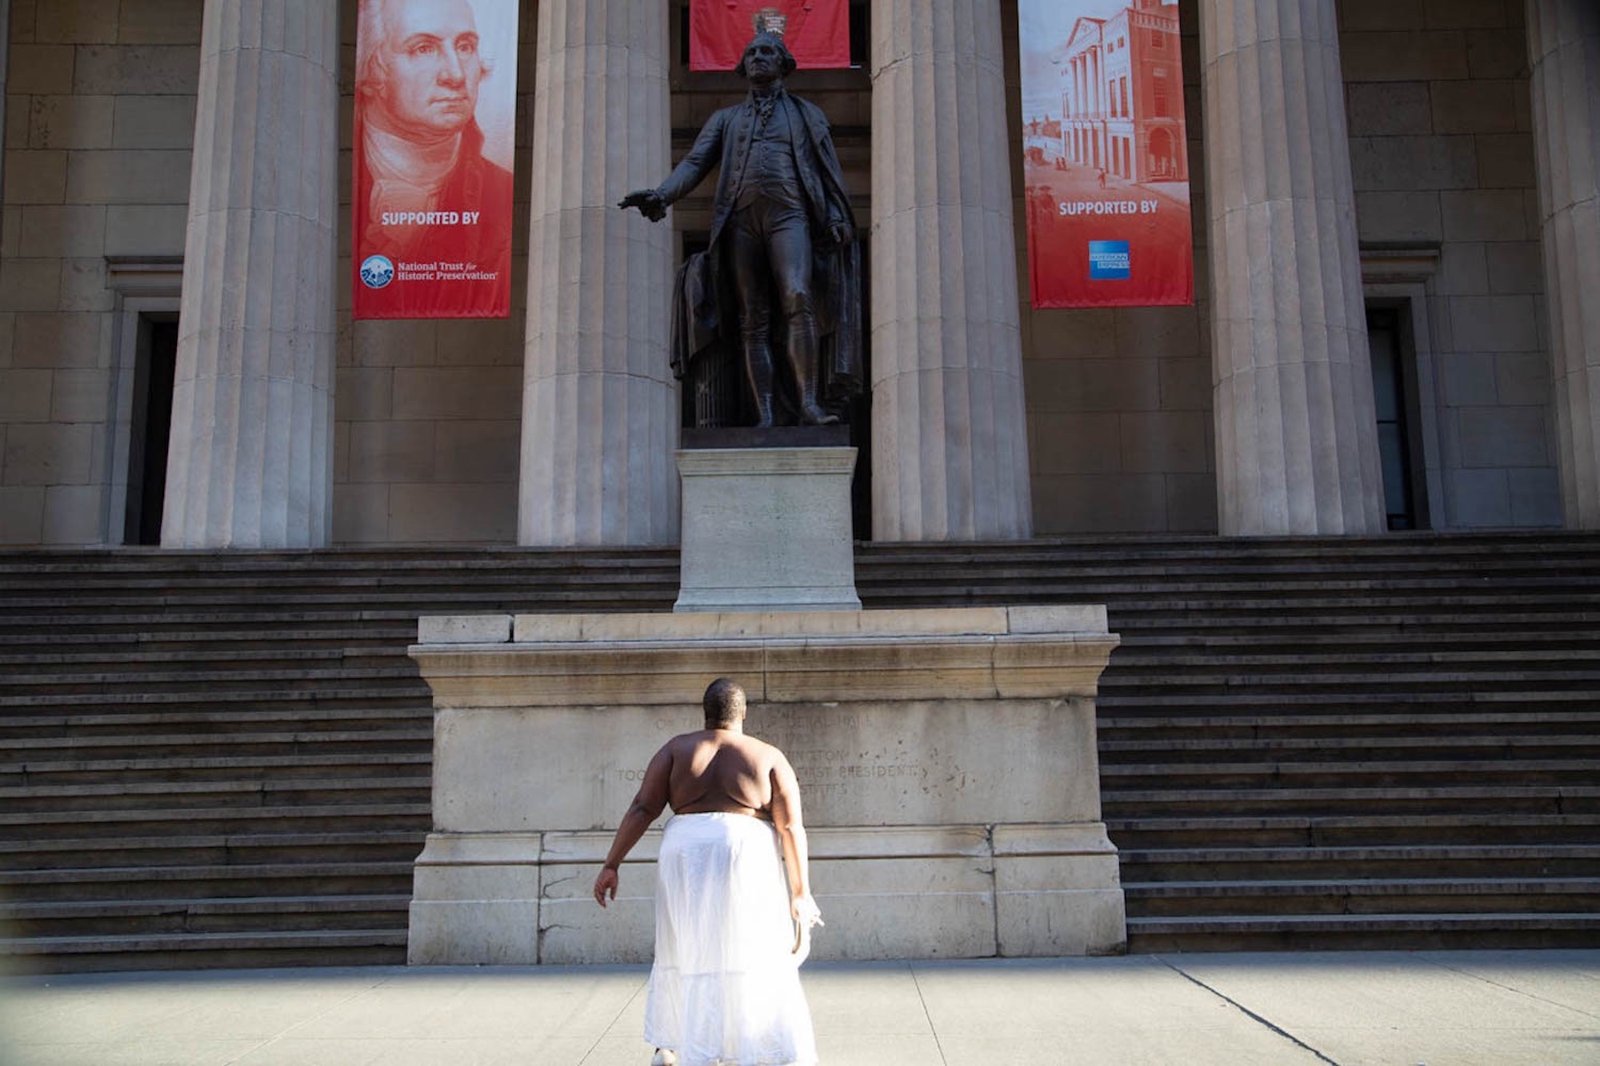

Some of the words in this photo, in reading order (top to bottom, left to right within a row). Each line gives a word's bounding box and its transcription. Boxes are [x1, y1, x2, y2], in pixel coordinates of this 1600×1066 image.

[1059, 200, 1137, 216] SUPPORTED
[1140, 200, 1158, 214] BY
[382, 212, 459, 225] SUPPORTED
[463, 212, 480, 225] BY
[397, 262, 437, 271] National
[439, 262, 464, 271] Trust
[464, 261, 477, 273] for
[397, 271, 434, 281] Historic
[436, 271, 496, 281] Preservation
[616, 768, 646, 781] TOO
